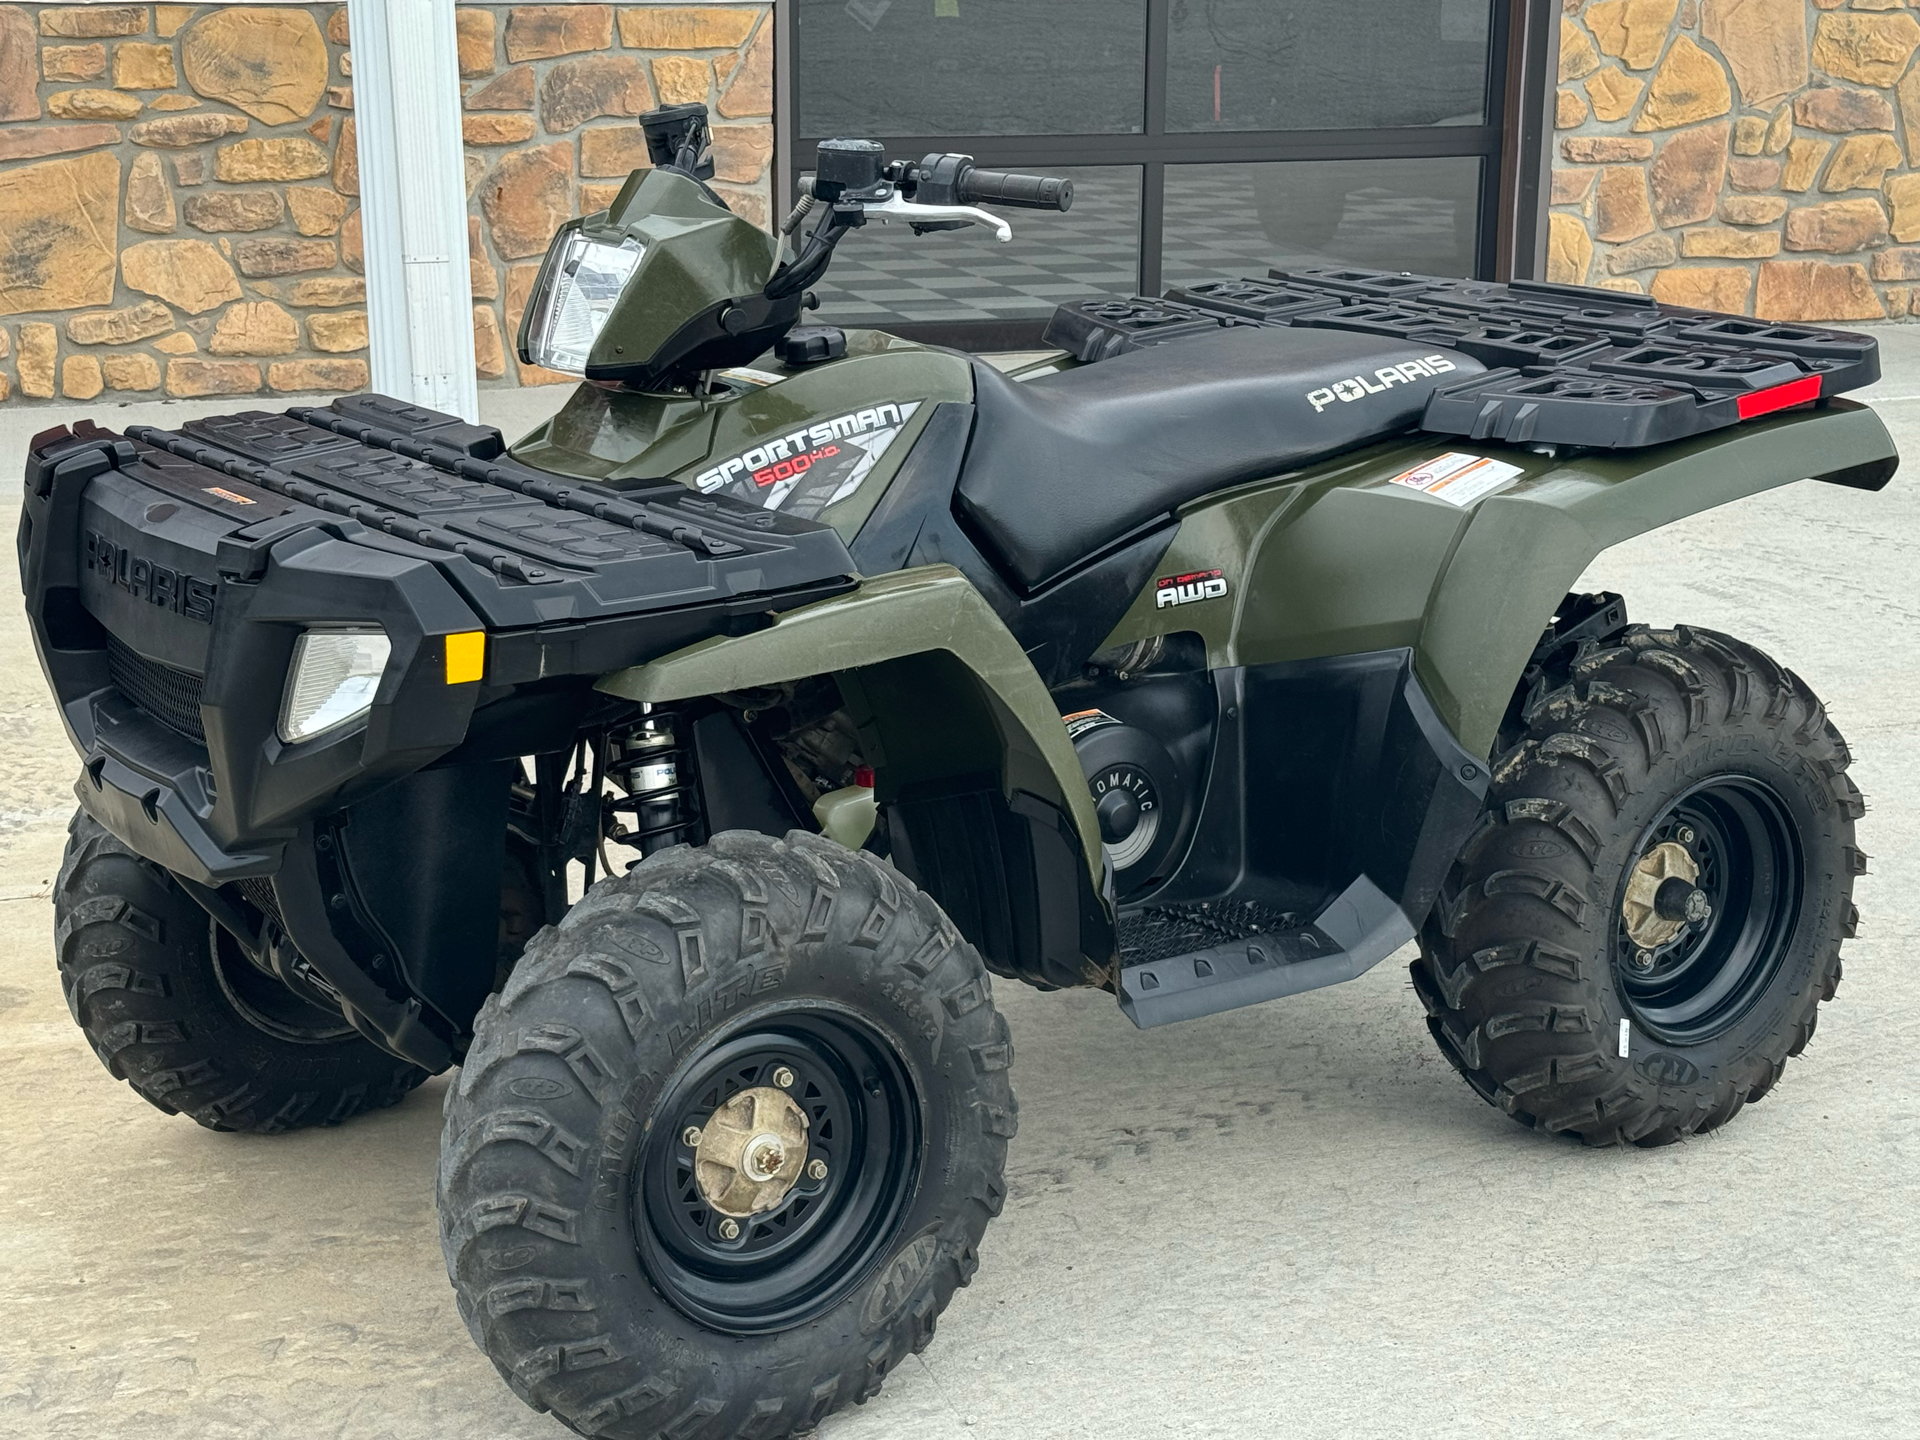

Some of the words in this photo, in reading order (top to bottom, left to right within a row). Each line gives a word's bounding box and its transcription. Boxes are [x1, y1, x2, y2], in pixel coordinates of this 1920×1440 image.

[1305, 354, 1457, 413] POLARIS
[696, 403, 900, 495] SPORTSMAN
[85, 530, 217, 625] POLARIS
[1157, 578, 1228, 608] AWD
[1176, 568, 1222, 584] DEMAND
[1092, 772, 1153, 812] OMATIC
